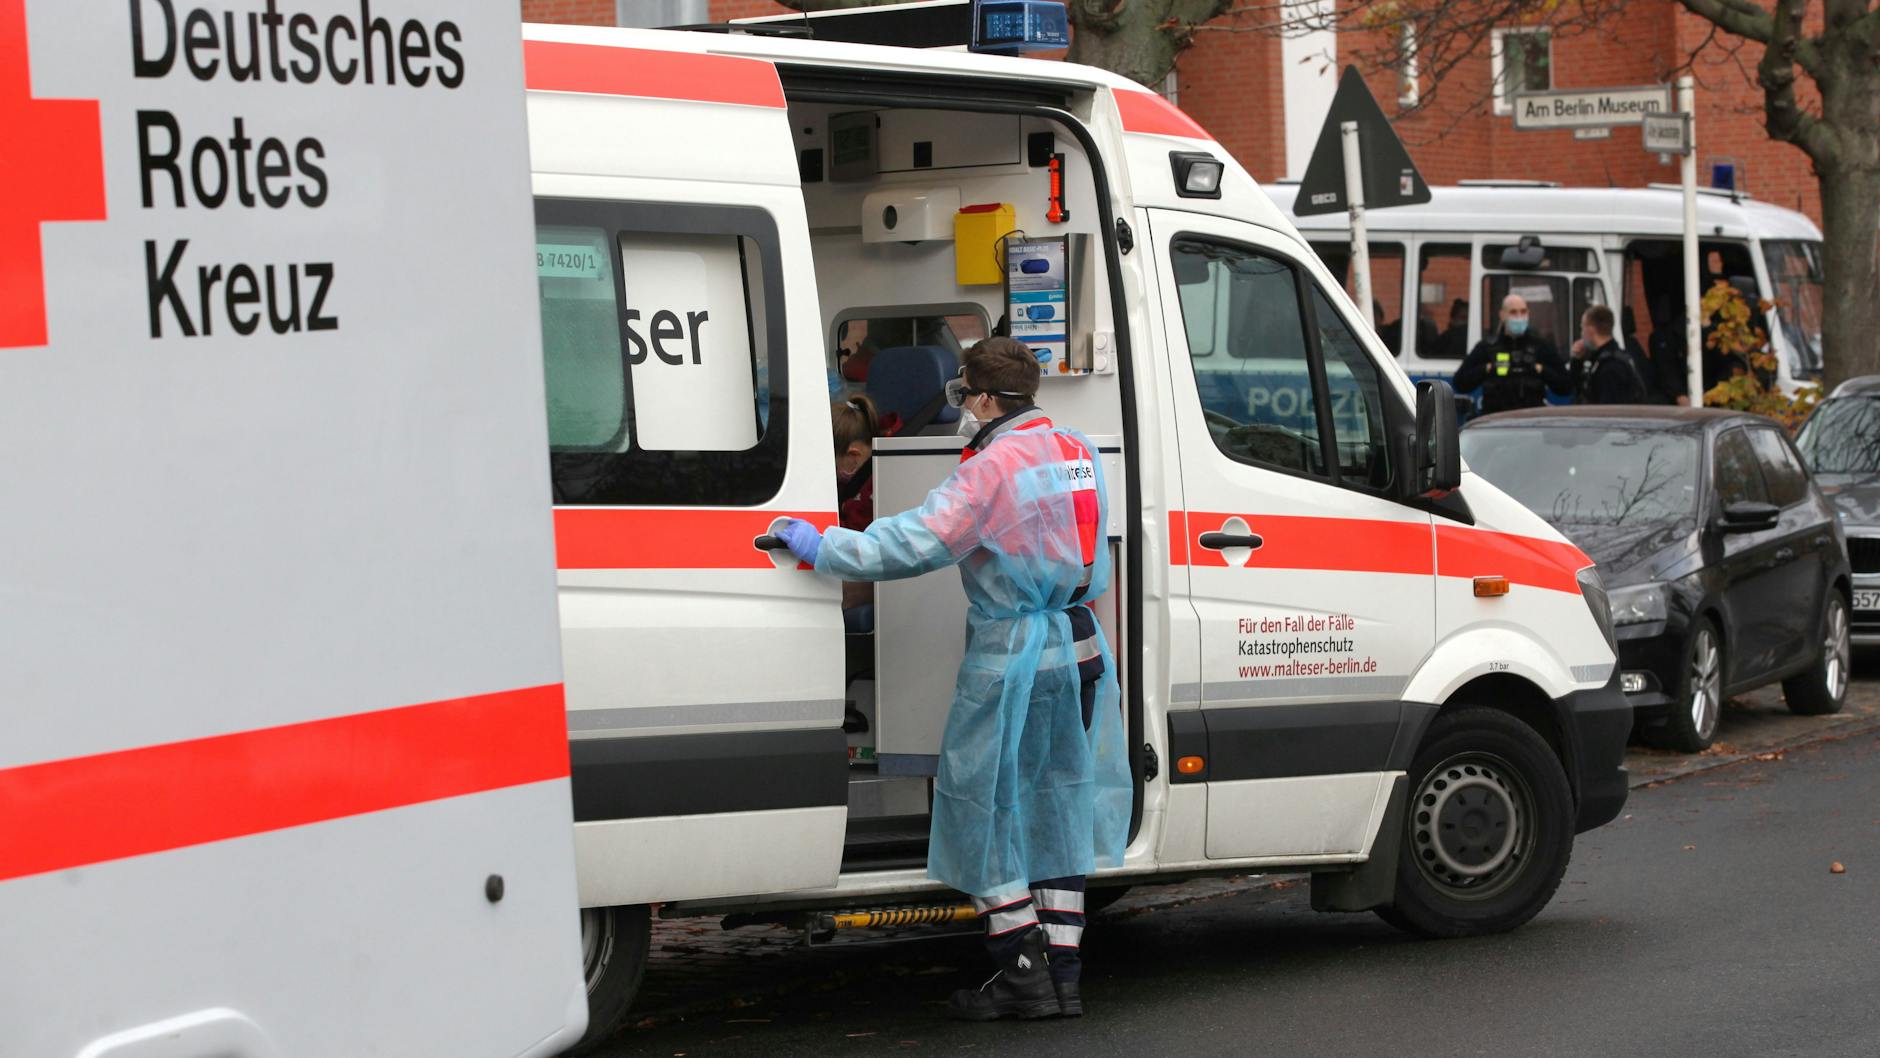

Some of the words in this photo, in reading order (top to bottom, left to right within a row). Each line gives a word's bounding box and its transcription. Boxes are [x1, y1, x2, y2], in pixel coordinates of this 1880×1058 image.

[128, 0, 465, 89] Deutsches
[1525, 101, 1550, 118] Am
[1554, 98, 1594, 117] Berlin
[1598, 97, 1661, 114] Museum
[136, 109, 329, 210] Rotes
[548, 252, 597, 272] 7420/1
[144, 238, 339, 339] Kreuz
[1238, 617, 1258, 634] Für
[1260, 616, 1282, 633] den
[1285, 615, 1304, 632] Fall
[1307, 615, 1326, 632] der
[1328, 614, 1354, 631] Fälle
[1238, 636, 1354, 658] Katastrophenschutz
[1238, 656, 1377, 678] www.malteser-berlin.de
[1500, 661, 1510, 670] bar
